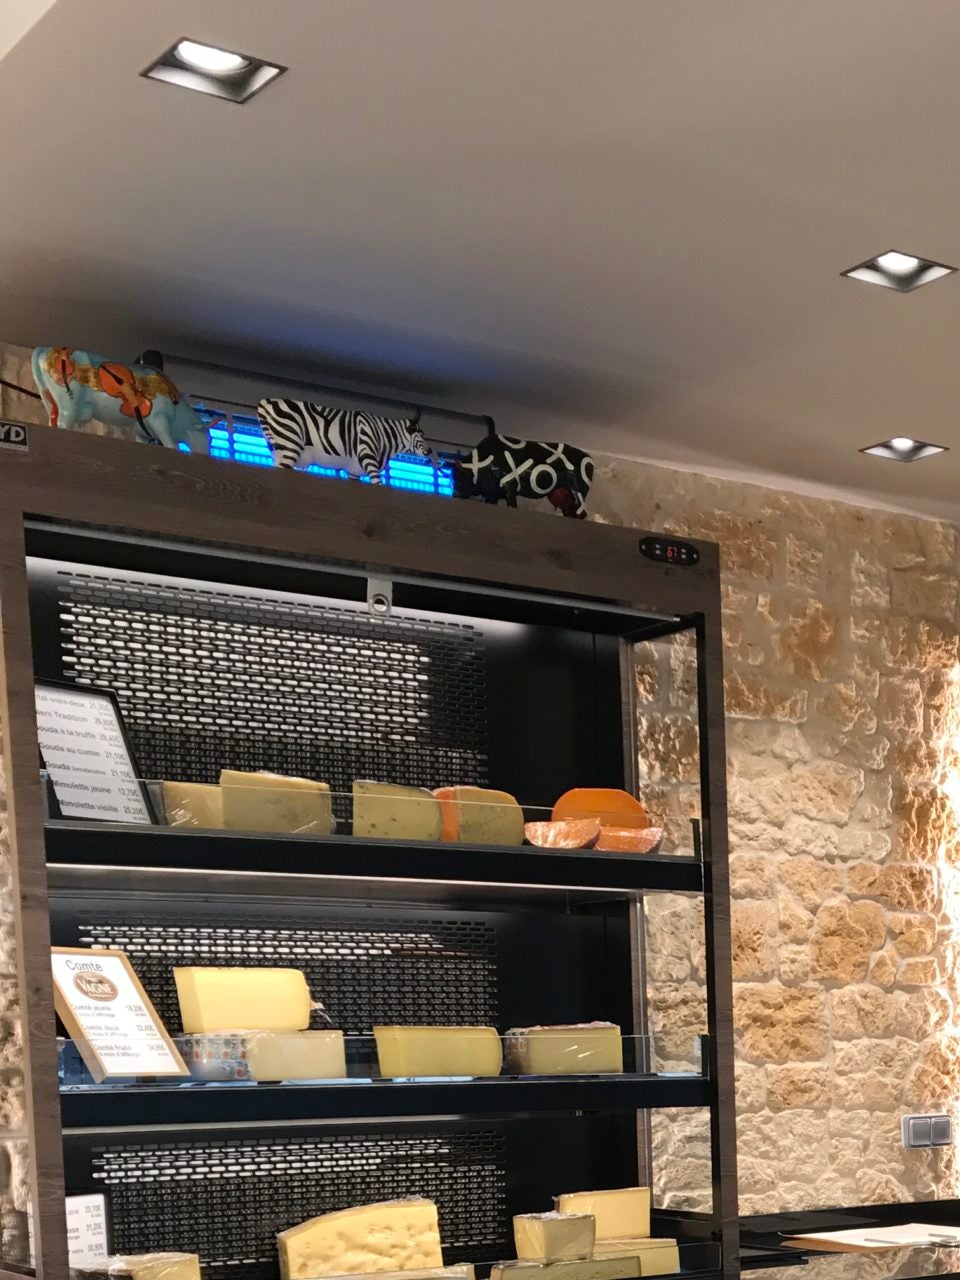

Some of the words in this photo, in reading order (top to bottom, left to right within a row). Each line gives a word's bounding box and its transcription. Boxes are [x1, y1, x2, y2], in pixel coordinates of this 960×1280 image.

[39, 725, 59, 735] ouda
[54, 780, 90, 792] Mimolette
[91, 785, 112, 795] jeune
[60, 799, 96, 811] Mimolette
[65, 959, 104, 973] Comté
